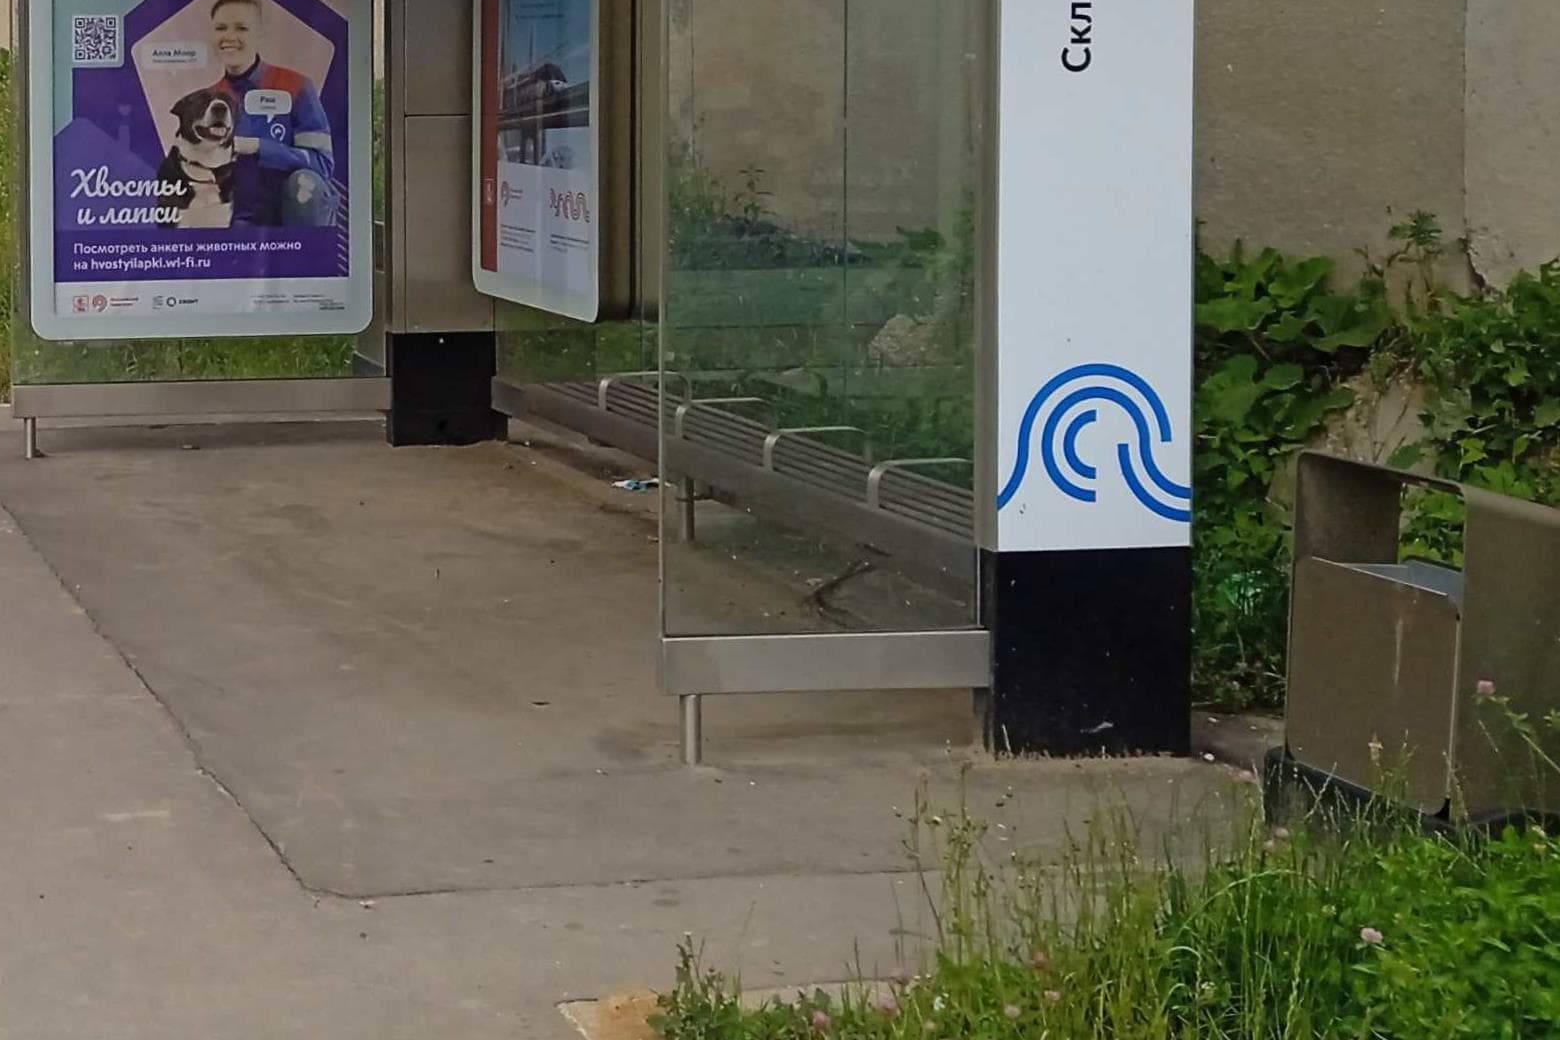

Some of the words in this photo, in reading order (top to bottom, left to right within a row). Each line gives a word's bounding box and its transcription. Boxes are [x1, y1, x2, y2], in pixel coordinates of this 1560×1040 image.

[70, 165, 188, 198] Хвосты
[77, 207, 96, 225] и
[99, 206, 182, 224] лапки
[73, 243, 148, 255] Посмотреть
[150, 243, 193, 253] анкеты
[196, 241, 257, 251] животных
[259, 240, 302, 251] можно
[73, 261, 88, 270] на
[91, 255, 211, 271] hvostyilapki.wi-fi.ru
